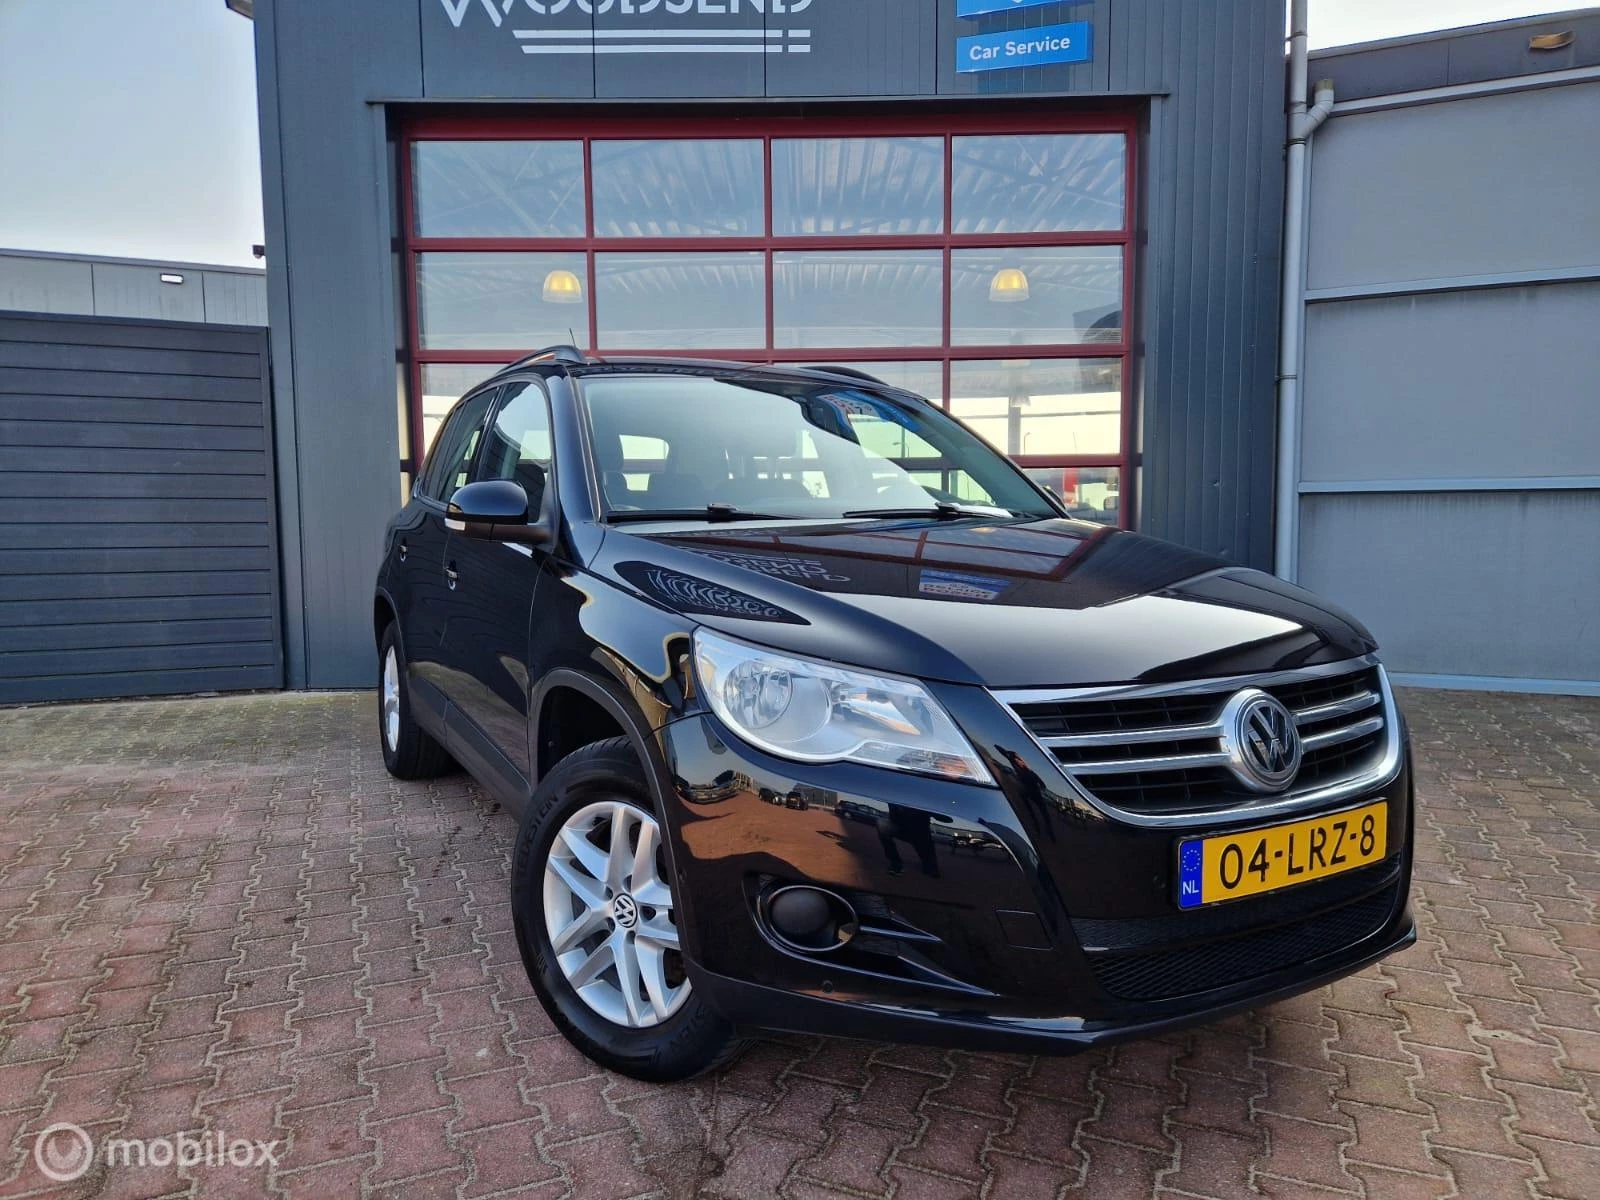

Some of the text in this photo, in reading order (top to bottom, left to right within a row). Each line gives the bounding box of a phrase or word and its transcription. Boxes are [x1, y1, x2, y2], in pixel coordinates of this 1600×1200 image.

[969, 36, 1071, 61] Car Service
[1219, 813, 1376, 890] 04-LRZ-8
[1182, 880, 1200, 896] NL
